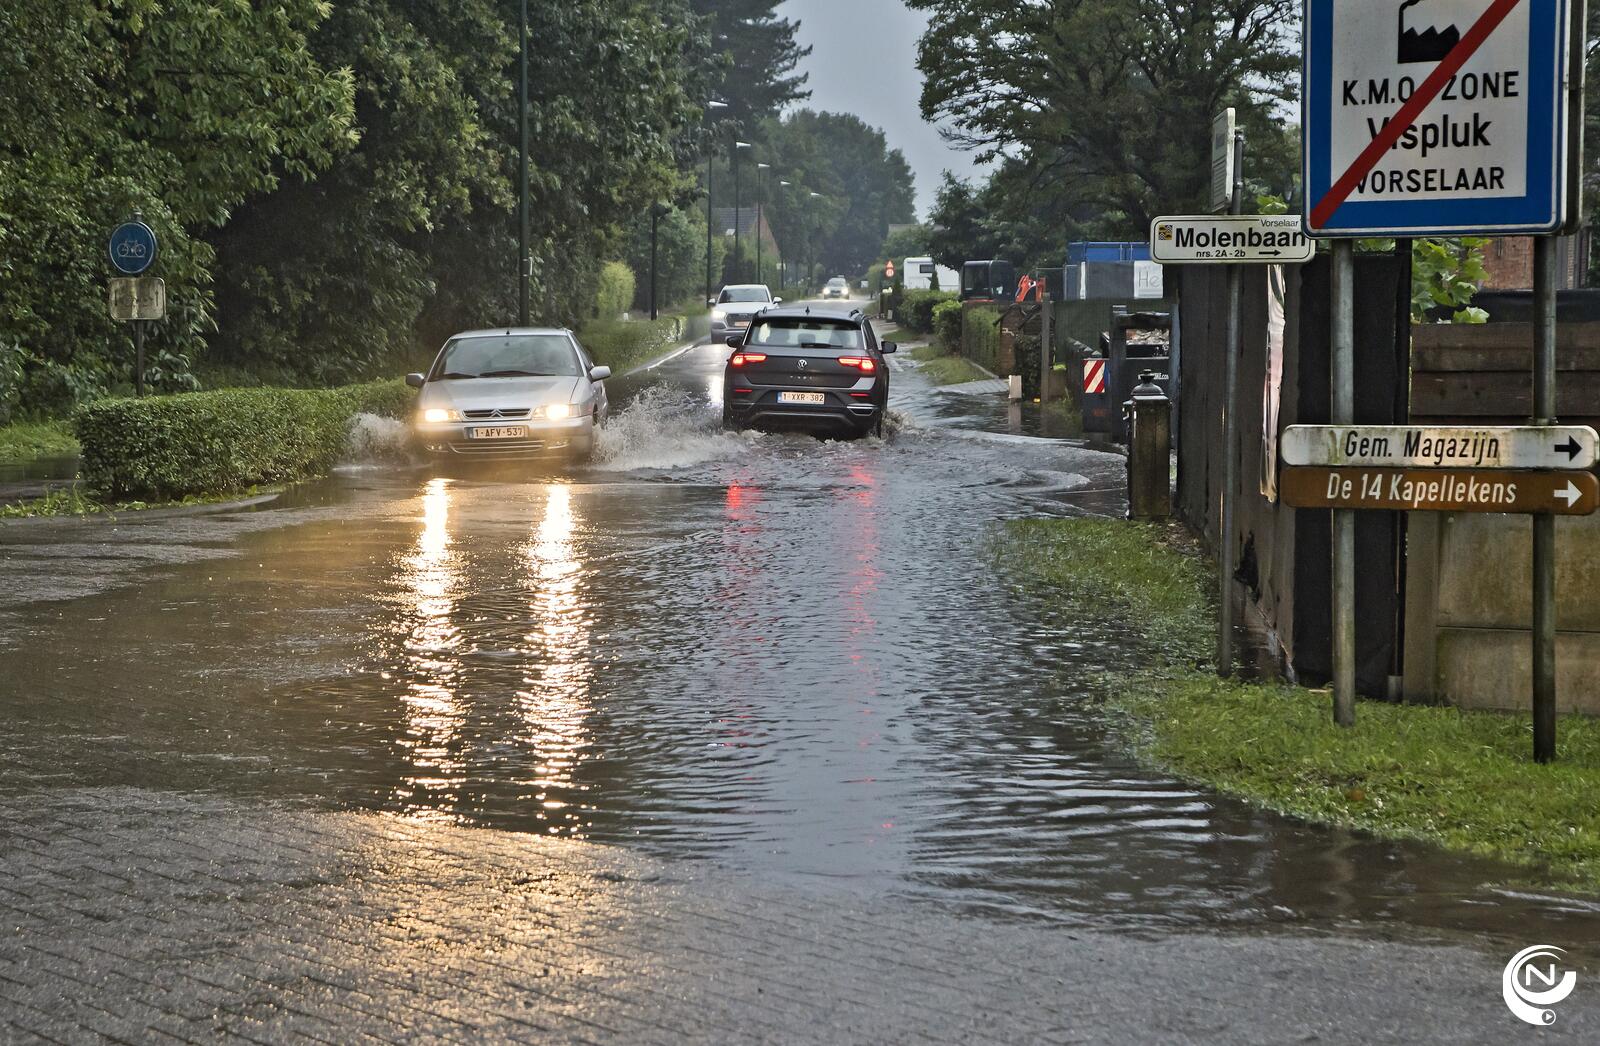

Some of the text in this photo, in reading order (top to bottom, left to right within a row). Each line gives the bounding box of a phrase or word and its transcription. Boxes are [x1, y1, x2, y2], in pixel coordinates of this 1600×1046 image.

[1441, 70, 1520, 101] ZONE
[1367, 112, 1493, 158] Vspluk
[1175, 227, 1306, 248] Molenbaan
[1260, 219, 1299, 227] Vorselaar
[1195, 250, 1213, 258] nrs.
[1345, 430, 1500, 466] Gem. Magazijn
[1326, 472, 1518, 509] De 14 Kapellekens
